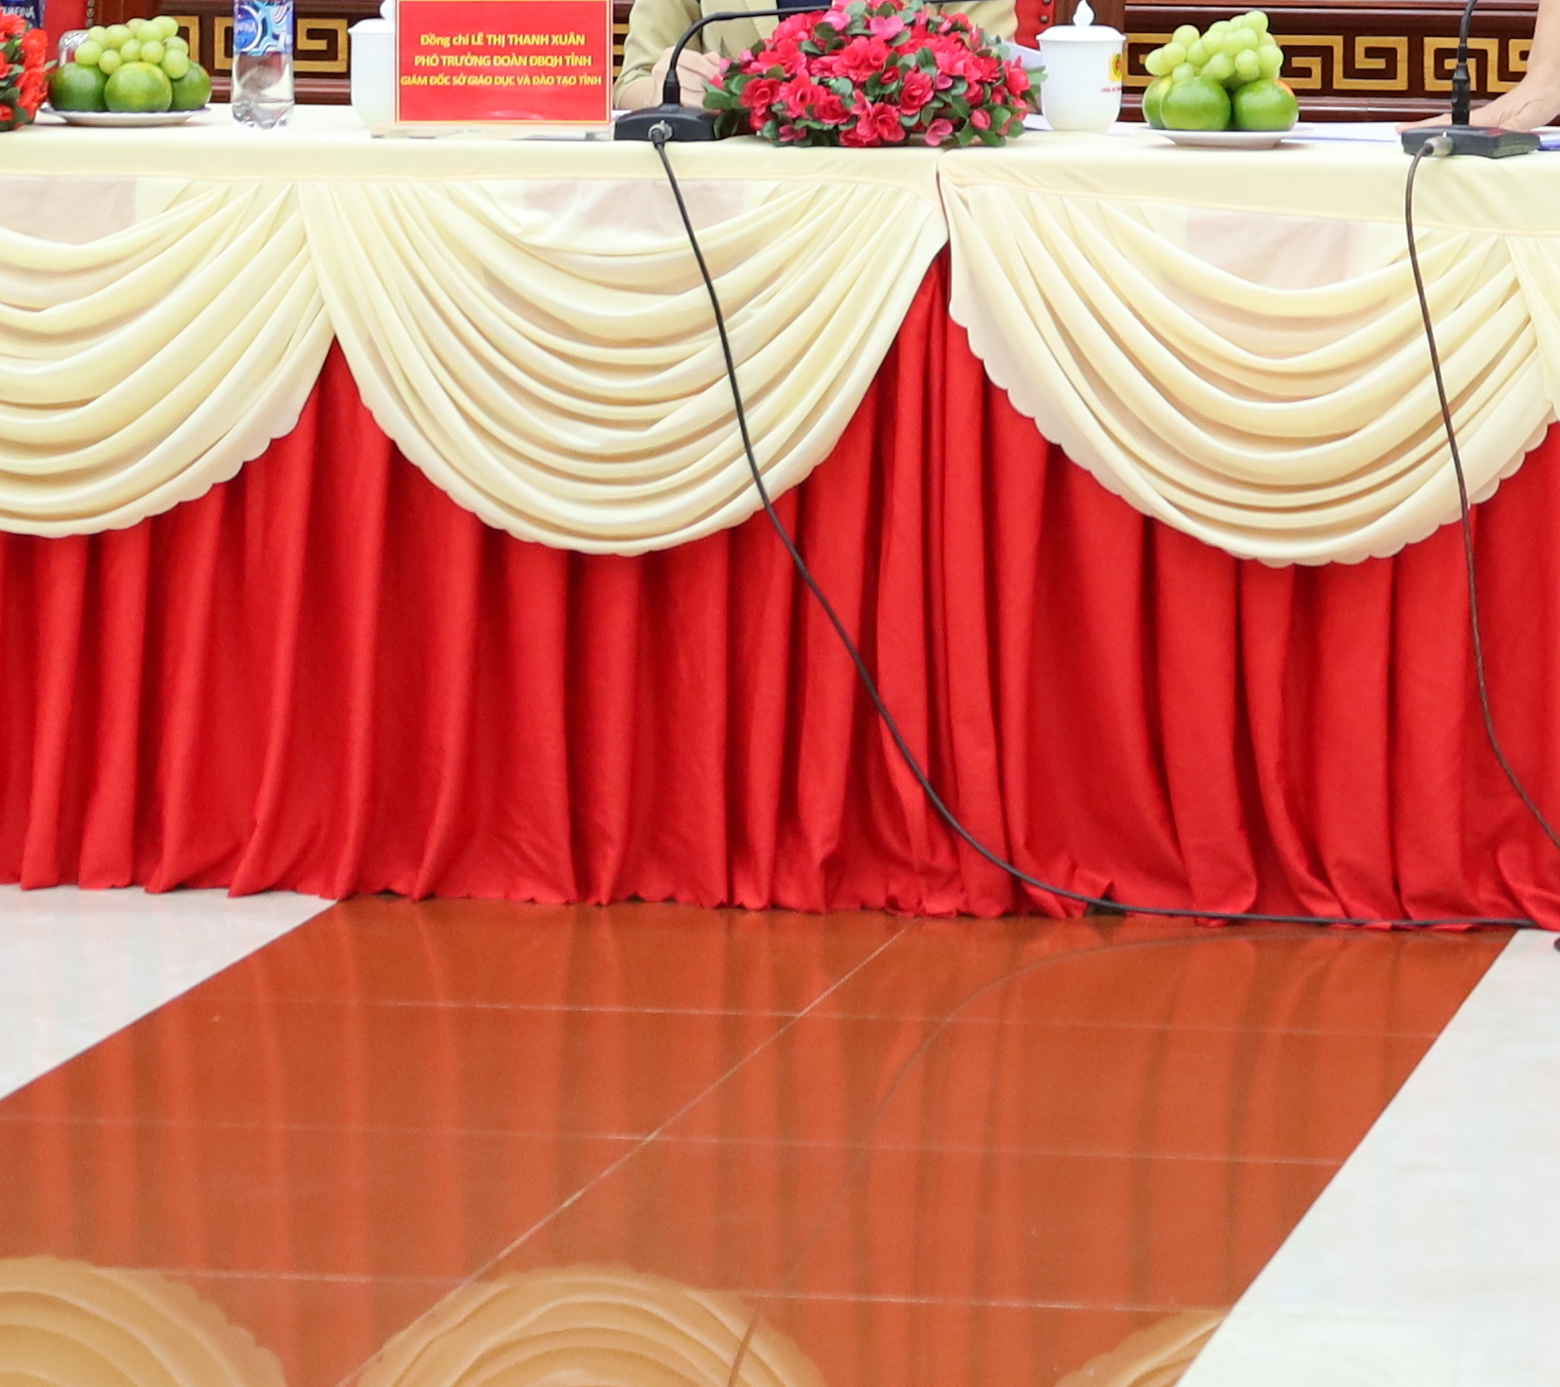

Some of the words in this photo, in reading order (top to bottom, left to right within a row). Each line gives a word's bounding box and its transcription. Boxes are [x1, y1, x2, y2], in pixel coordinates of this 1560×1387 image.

[420, 32, 451, 48] Đồng
[452, 33, 470, 46] chí
[471, 32, 484, 46] LÊ
[487, 34, 506, 48] THỊ
[508, 34, 549, 46] THANH
[551, 31, 585, 46] XUÂN
[414, 53, 439, 67] PHÓ
[441, 52, 492, 67] TRƯỞNG
[493, 53, 528, 67] ĐOÀN
[400, 74, 428, 86] GIÁM
[429, 73, 451, 86] ĐỐC
[467, 74, 493, 86] GIÁO
[494, 76, 515, 87] DỤC
[517, 74, 532, 86] VÀ
[532, 74, 555, 86] ĐÀO
[557, 76, 576, 88] TẠO
